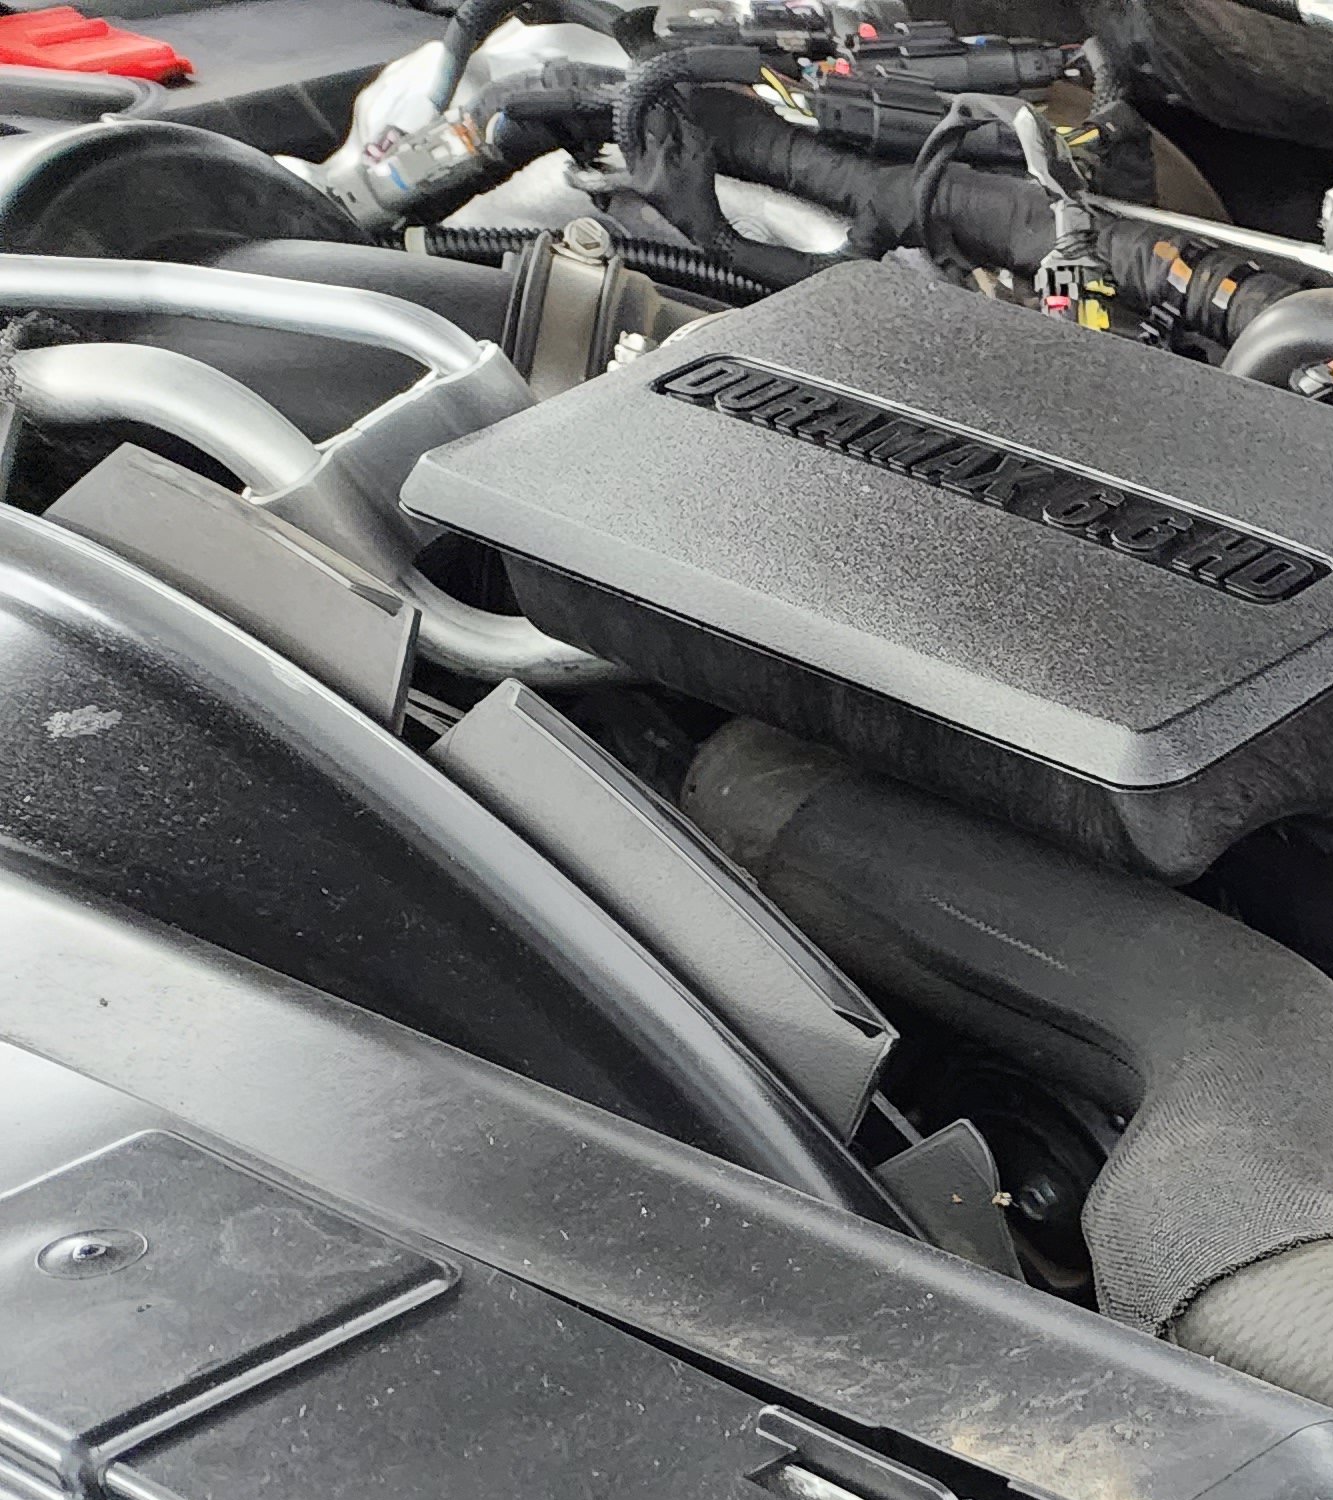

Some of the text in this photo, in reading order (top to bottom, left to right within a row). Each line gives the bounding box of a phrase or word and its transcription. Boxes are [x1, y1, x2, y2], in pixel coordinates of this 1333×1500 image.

[655, 360, 1316, 604] DURAMAX 6.6 HD
